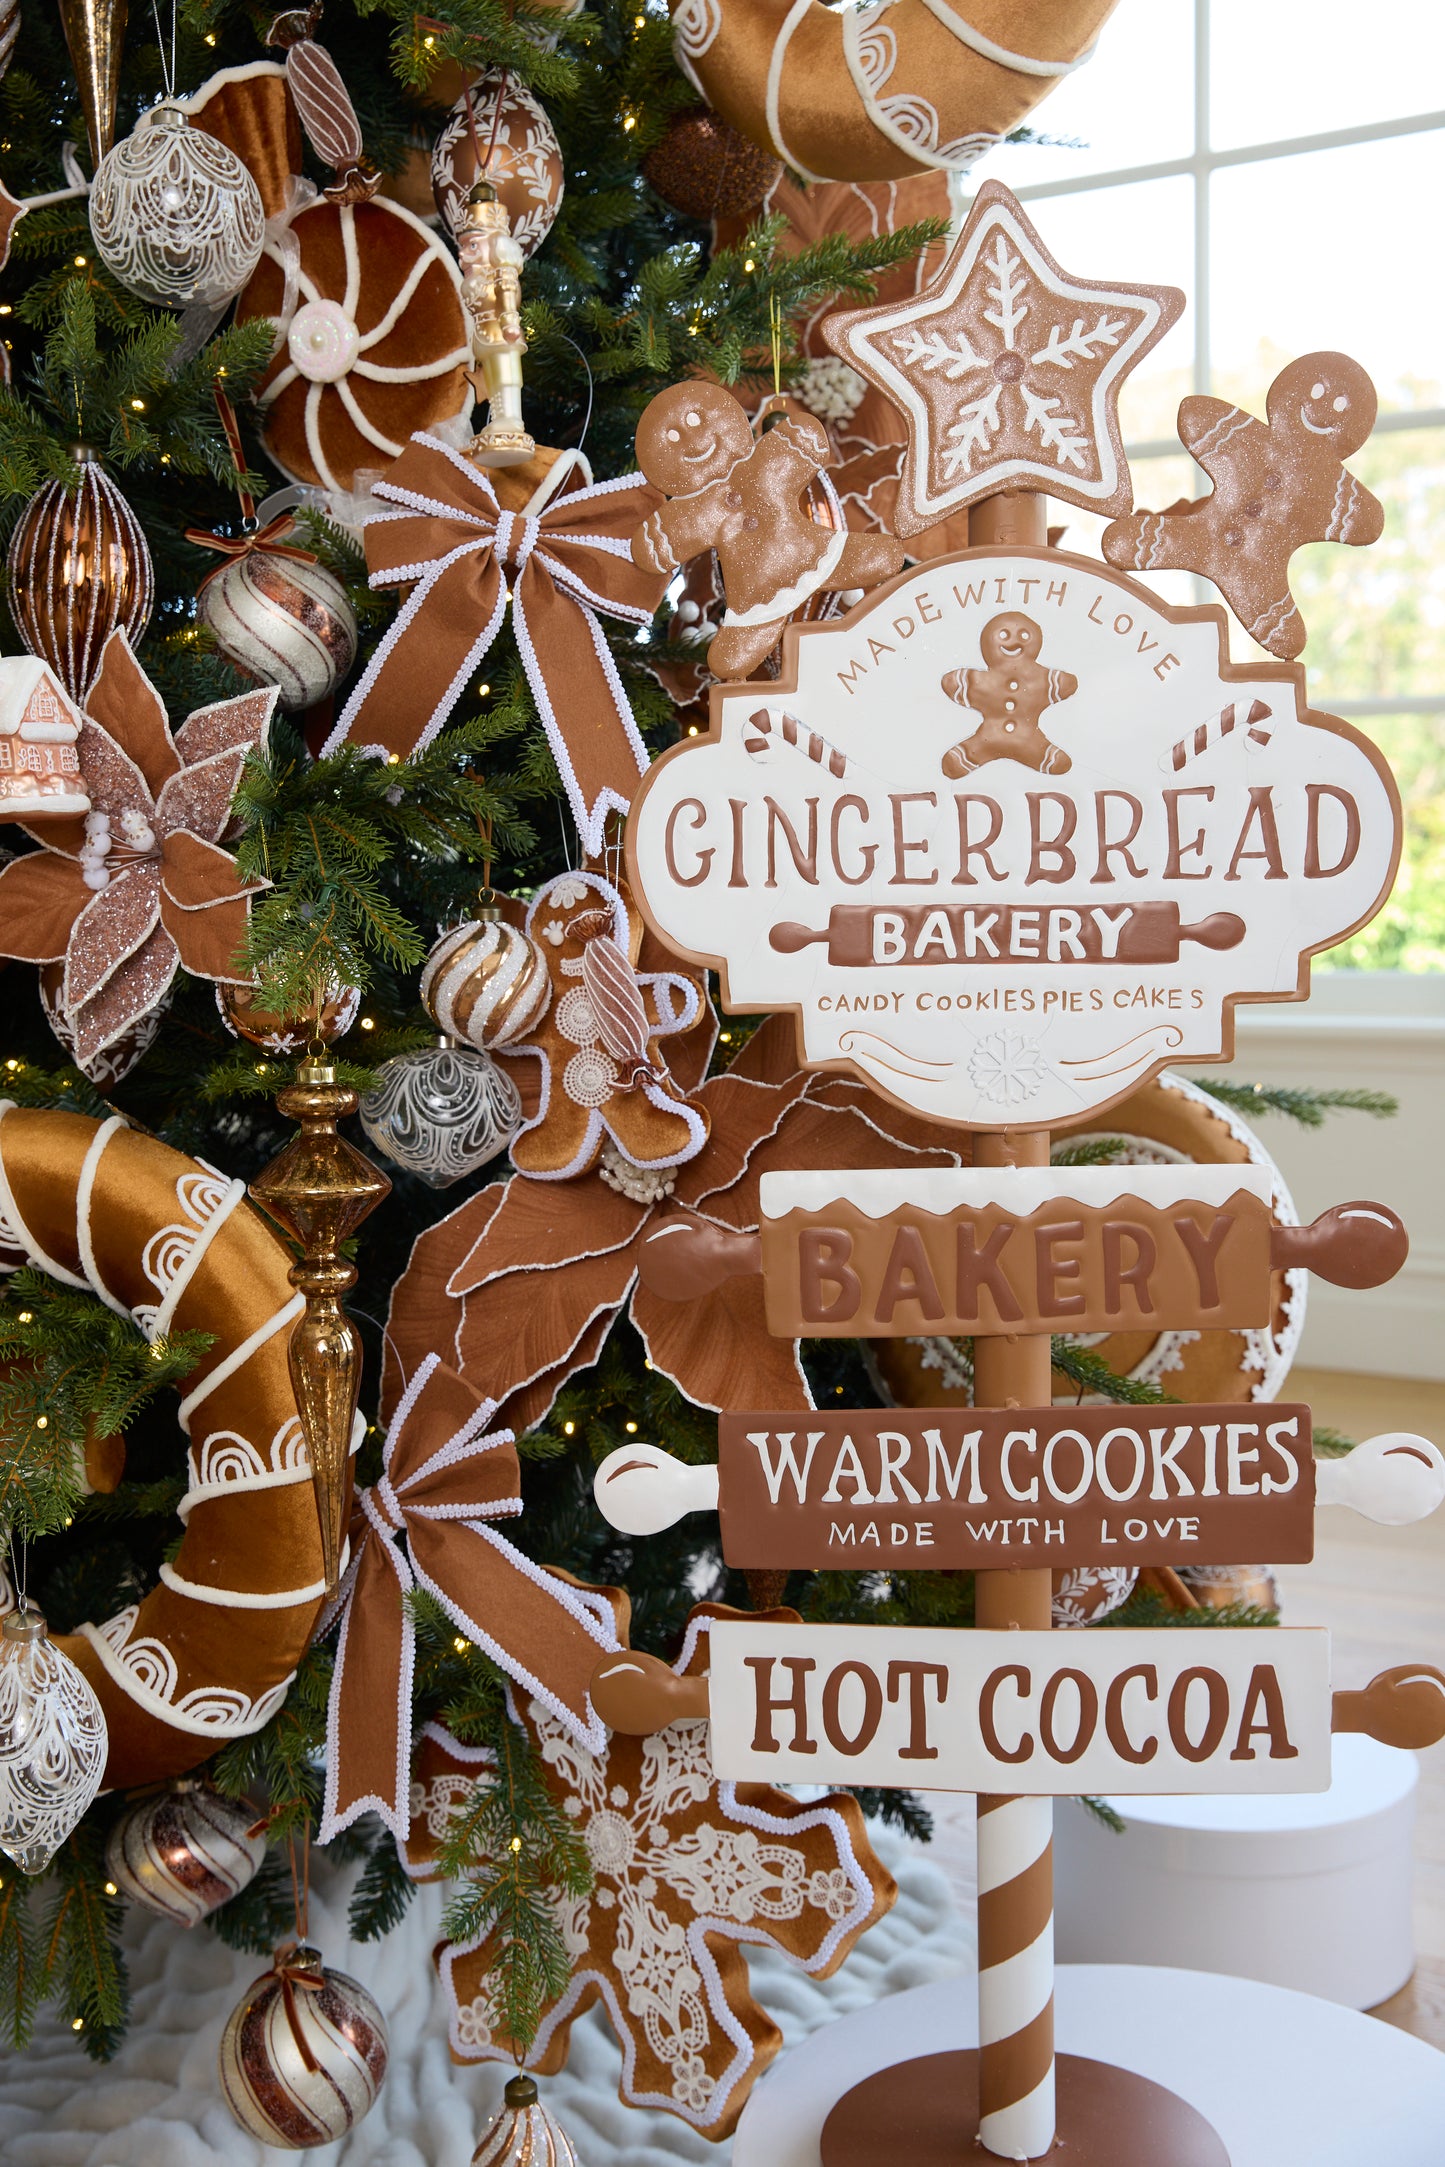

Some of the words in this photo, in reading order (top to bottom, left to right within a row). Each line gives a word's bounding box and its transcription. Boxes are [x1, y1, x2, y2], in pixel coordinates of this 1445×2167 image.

[836, 593, 943, 694] MADE
[953, 578, 1068, 609] WITH
[1088, 594, 1181, 681] LOVE
[664, 783, 1362, 889] GINGERBREAD
[872, 907, 1134, 963] BAKERY
[818, 991, 907, 1013] CANDY
[916, 989, 1035, 1013] COOKIES
[1043, 988, 1104, 1013] PIES
[1113, 986, 1205, 1010] CAKES
[800, 1214, 1236, 1324] BAKERY
[746, 1429, 988, 1505] WARM
[1000, 1417, 1299, 1504] COOKIES
[829, 1522, 934, 1547] MADE
[966, 1520, 1065, 1546] WITH
[1100, 1517, 1201, 1544] LOVE
[744, 1657, 949, 1760] HOT
[978, 1663, 1298, 1763] COCOA
